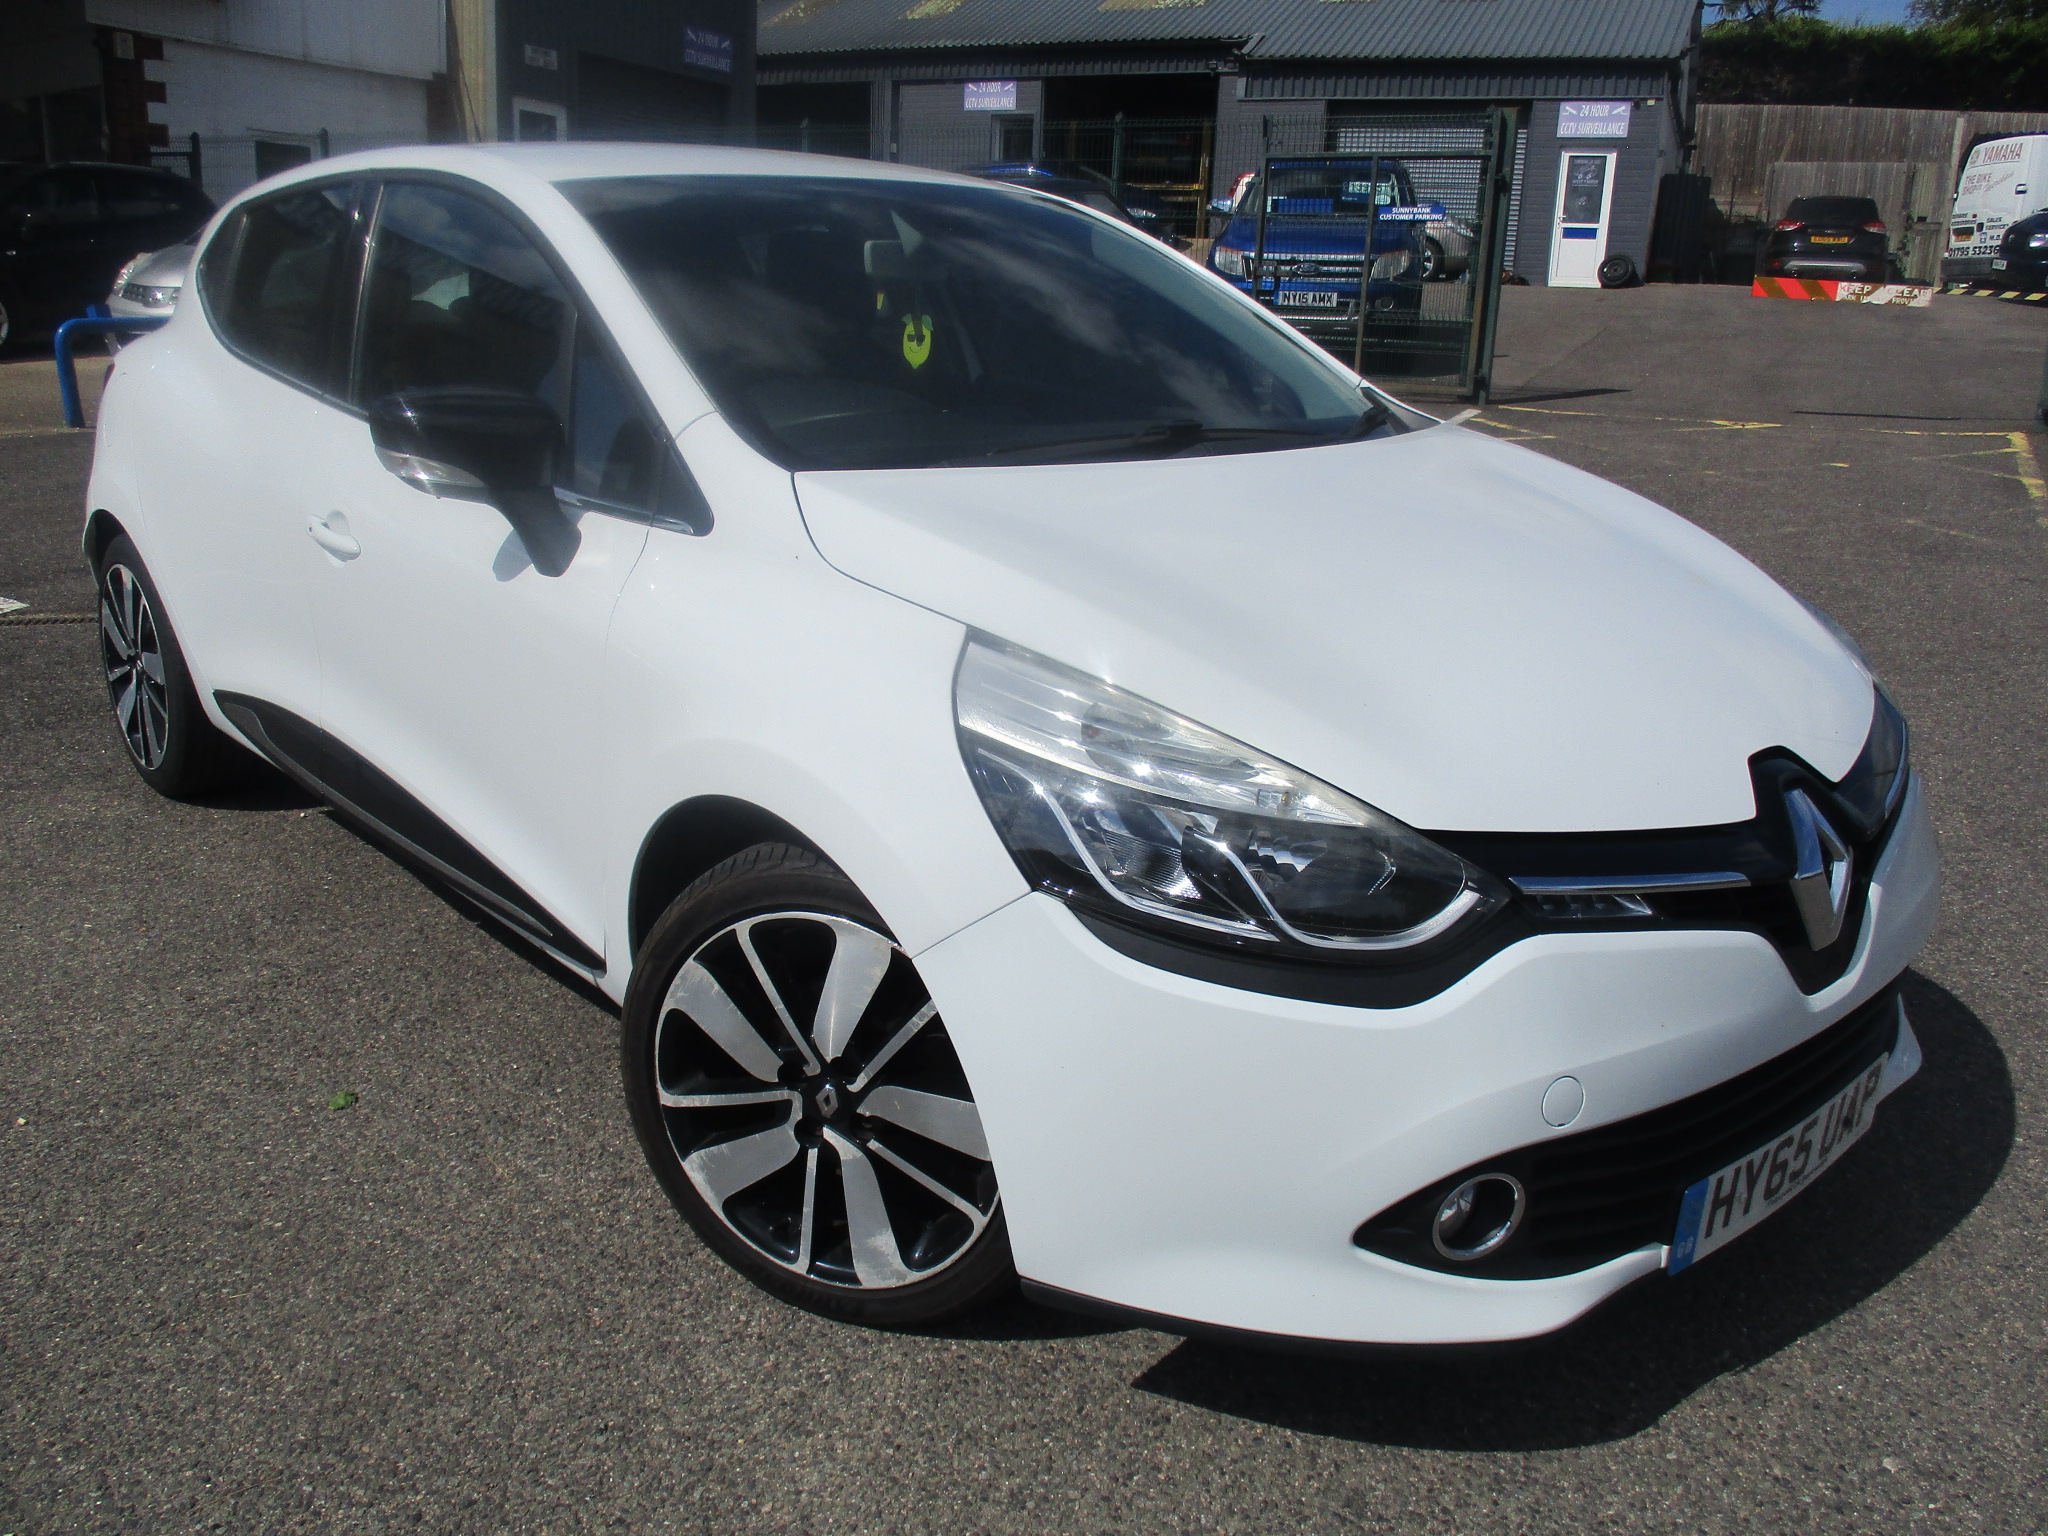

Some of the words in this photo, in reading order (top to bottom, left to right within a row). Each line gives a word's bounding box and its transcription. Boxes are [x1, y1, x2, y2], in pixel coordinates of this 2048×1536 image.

[979, 82, 986, 92] 24
[986, 82, 1001, 92] HOUR
[965, 98, 977, 108] CCTV
[978, 97, 1013, 108] SURVEILLANCE
[1580, 105, 1590, 117] 24
[1590, 105, 1609, 117] HOUR
[1560, 122, 1577, 134] CCTV
[1577, 122, 1625, 134] SURVEILLANCE
[1983, 143, 2023, 163] YAMAHA
[1948, 246, 1970, 257] 01795
[1971, 245, 2001, 256] 53236
[1840, 283, 1872, 294] KEEP
[1282, 291, 1308, 303] NY15
[1311, 292, 1333, 304] AMX
[1704, 1115, 1819, 1239] HY65
